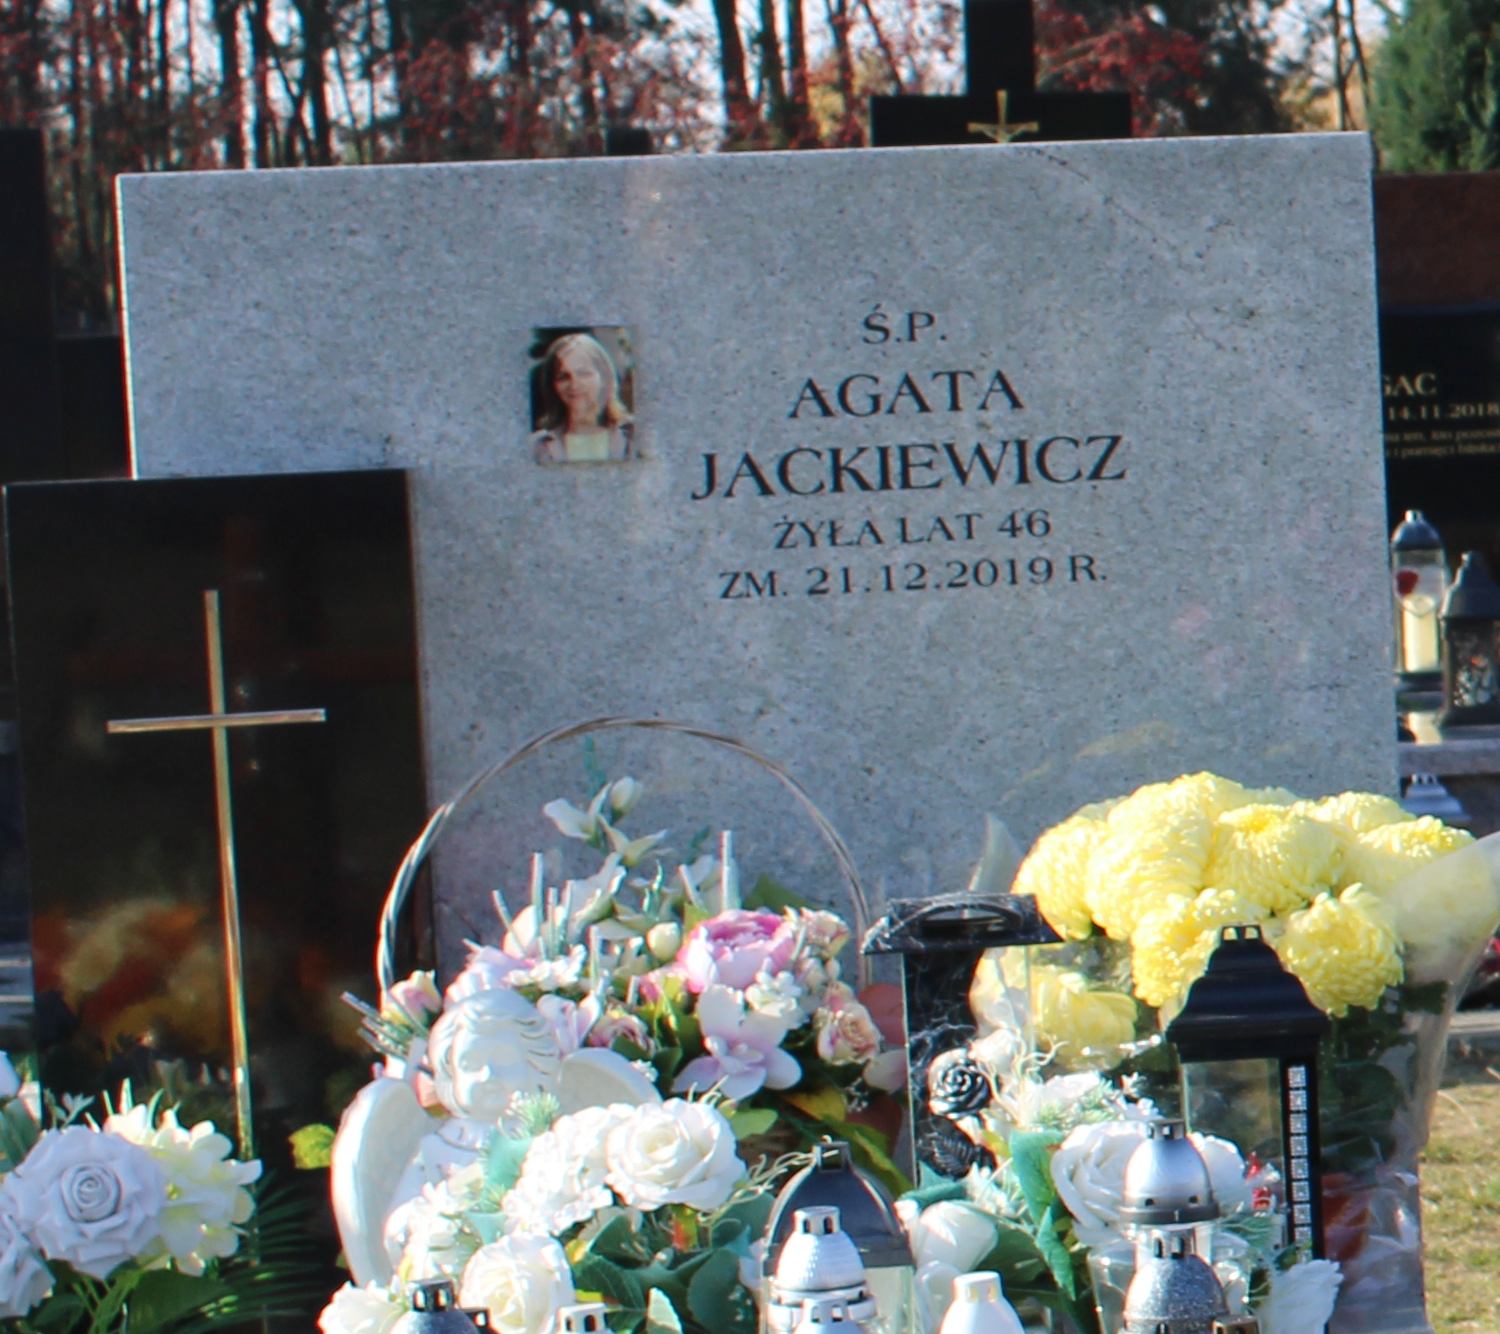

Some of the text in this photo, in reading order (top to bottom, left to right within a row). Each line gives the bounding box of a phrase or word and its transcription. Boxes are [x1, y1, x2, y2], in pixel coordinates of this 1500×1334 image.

[862, 303, 948, 345] Ś.P.
[787, 369, 1025, 420] AGATA
[690, 434, 1128, 501] JACKIEWICZ
[773, 509, 1052, 549] ŻYŁA LAT 46
[718, 553, 1109, 599] ZM. 21.12.2019 R.
